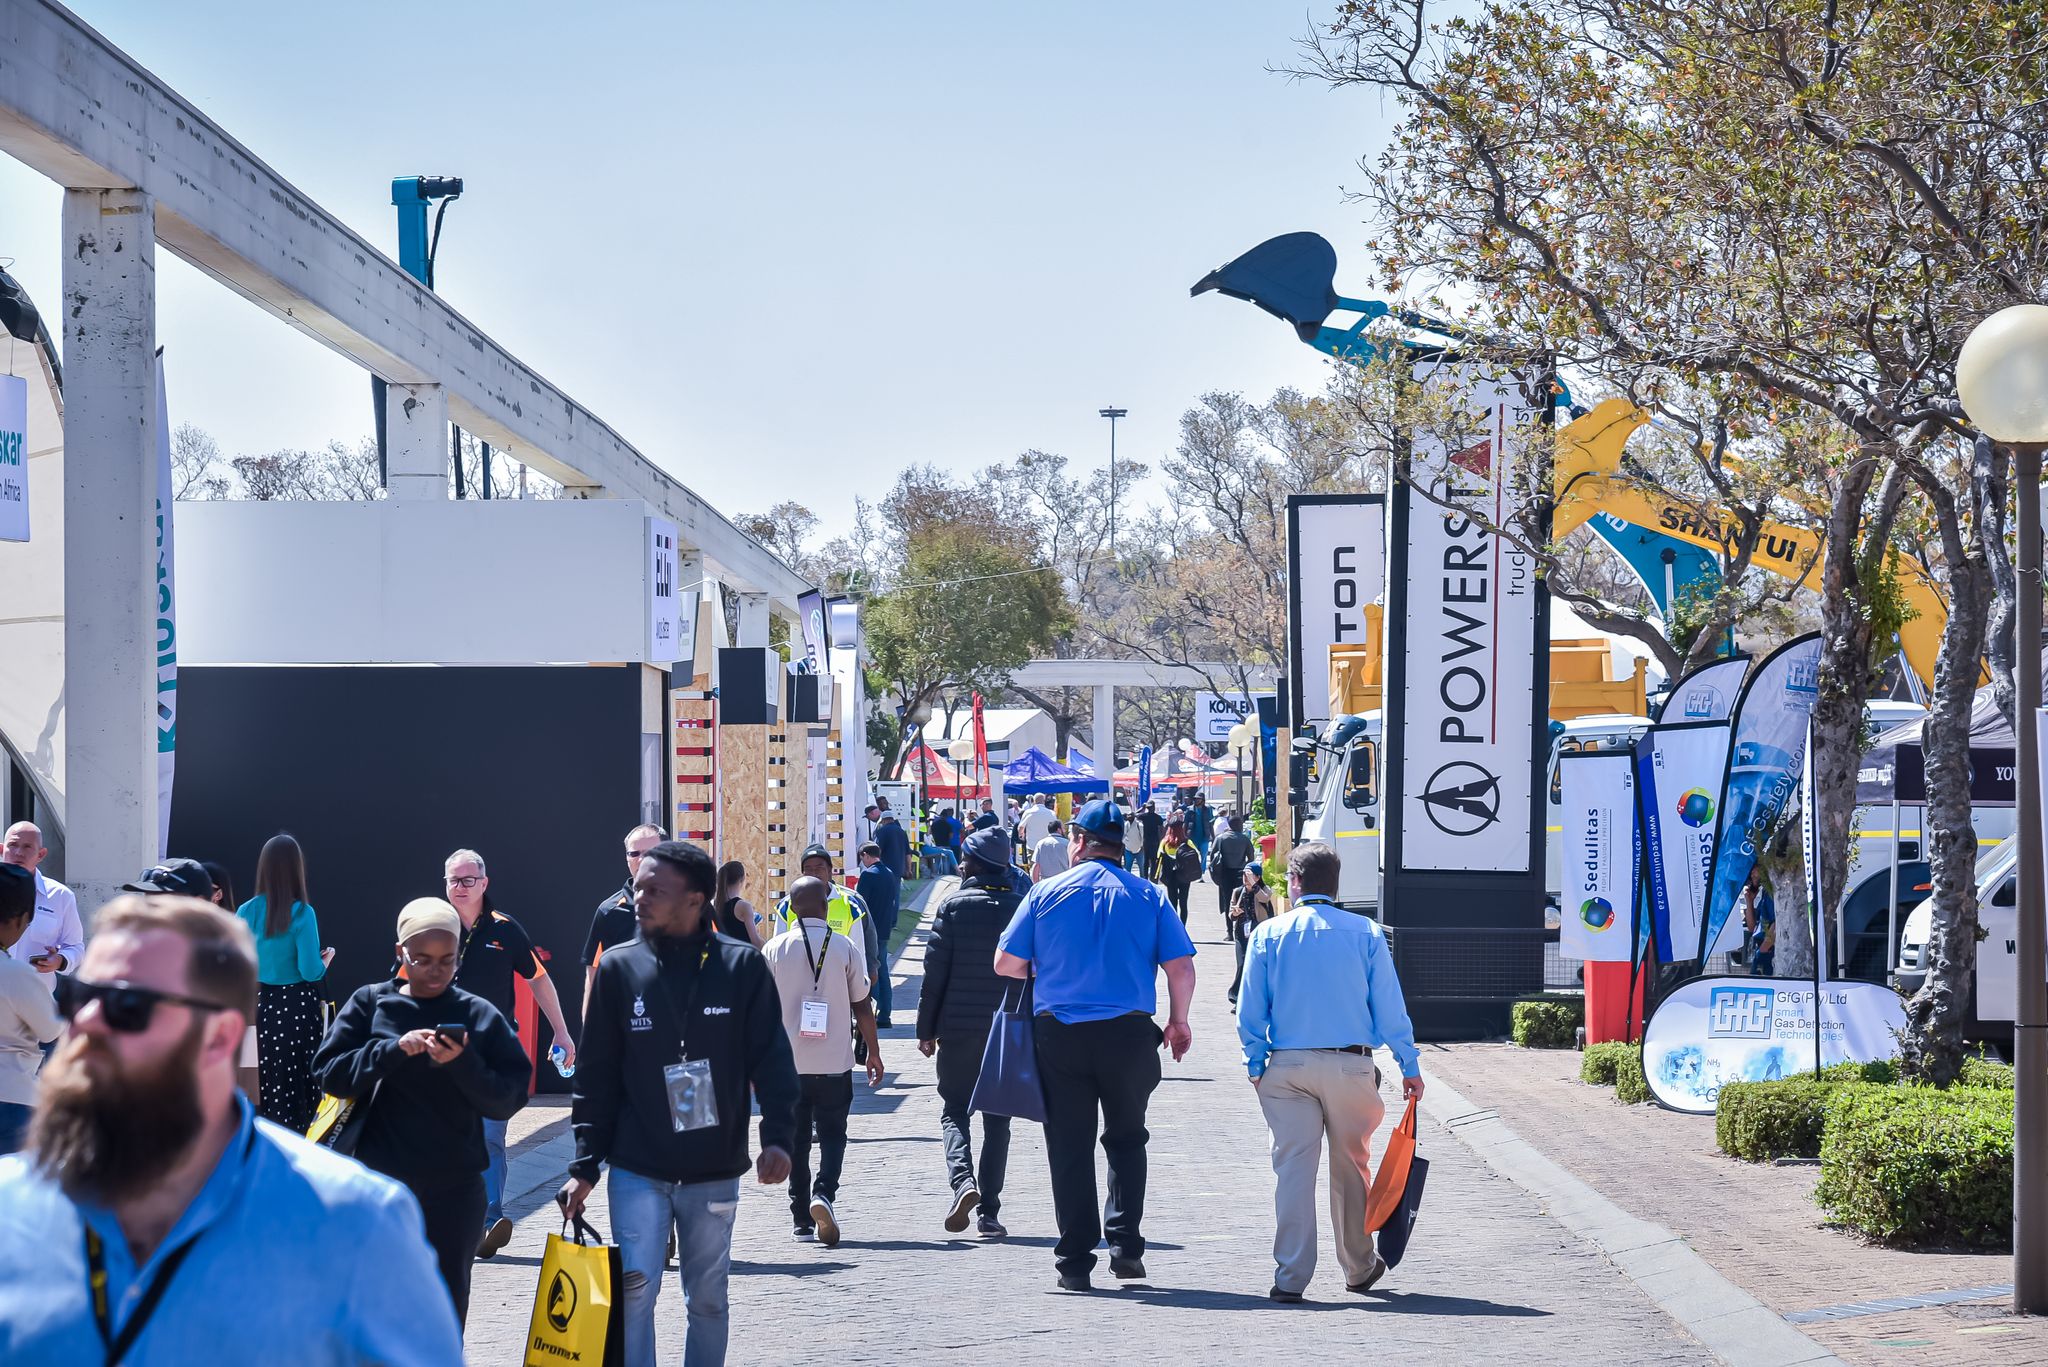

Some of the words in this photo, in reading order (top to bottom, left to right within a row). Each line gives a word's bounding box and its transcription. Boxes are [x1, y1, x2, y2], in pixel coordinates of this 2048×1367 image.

[1584, 808, 1598, 893] Sedulitas
[1776, 991, 1848, 1007] GfG(Py)Ltd
[1775, 1008, 1804, 1018] smart
[630, 1017, 652, 1027] WITS
[1774, 1018, 1795, 1029] Gas
[1797, 1018, 1846, 1031] Detction
